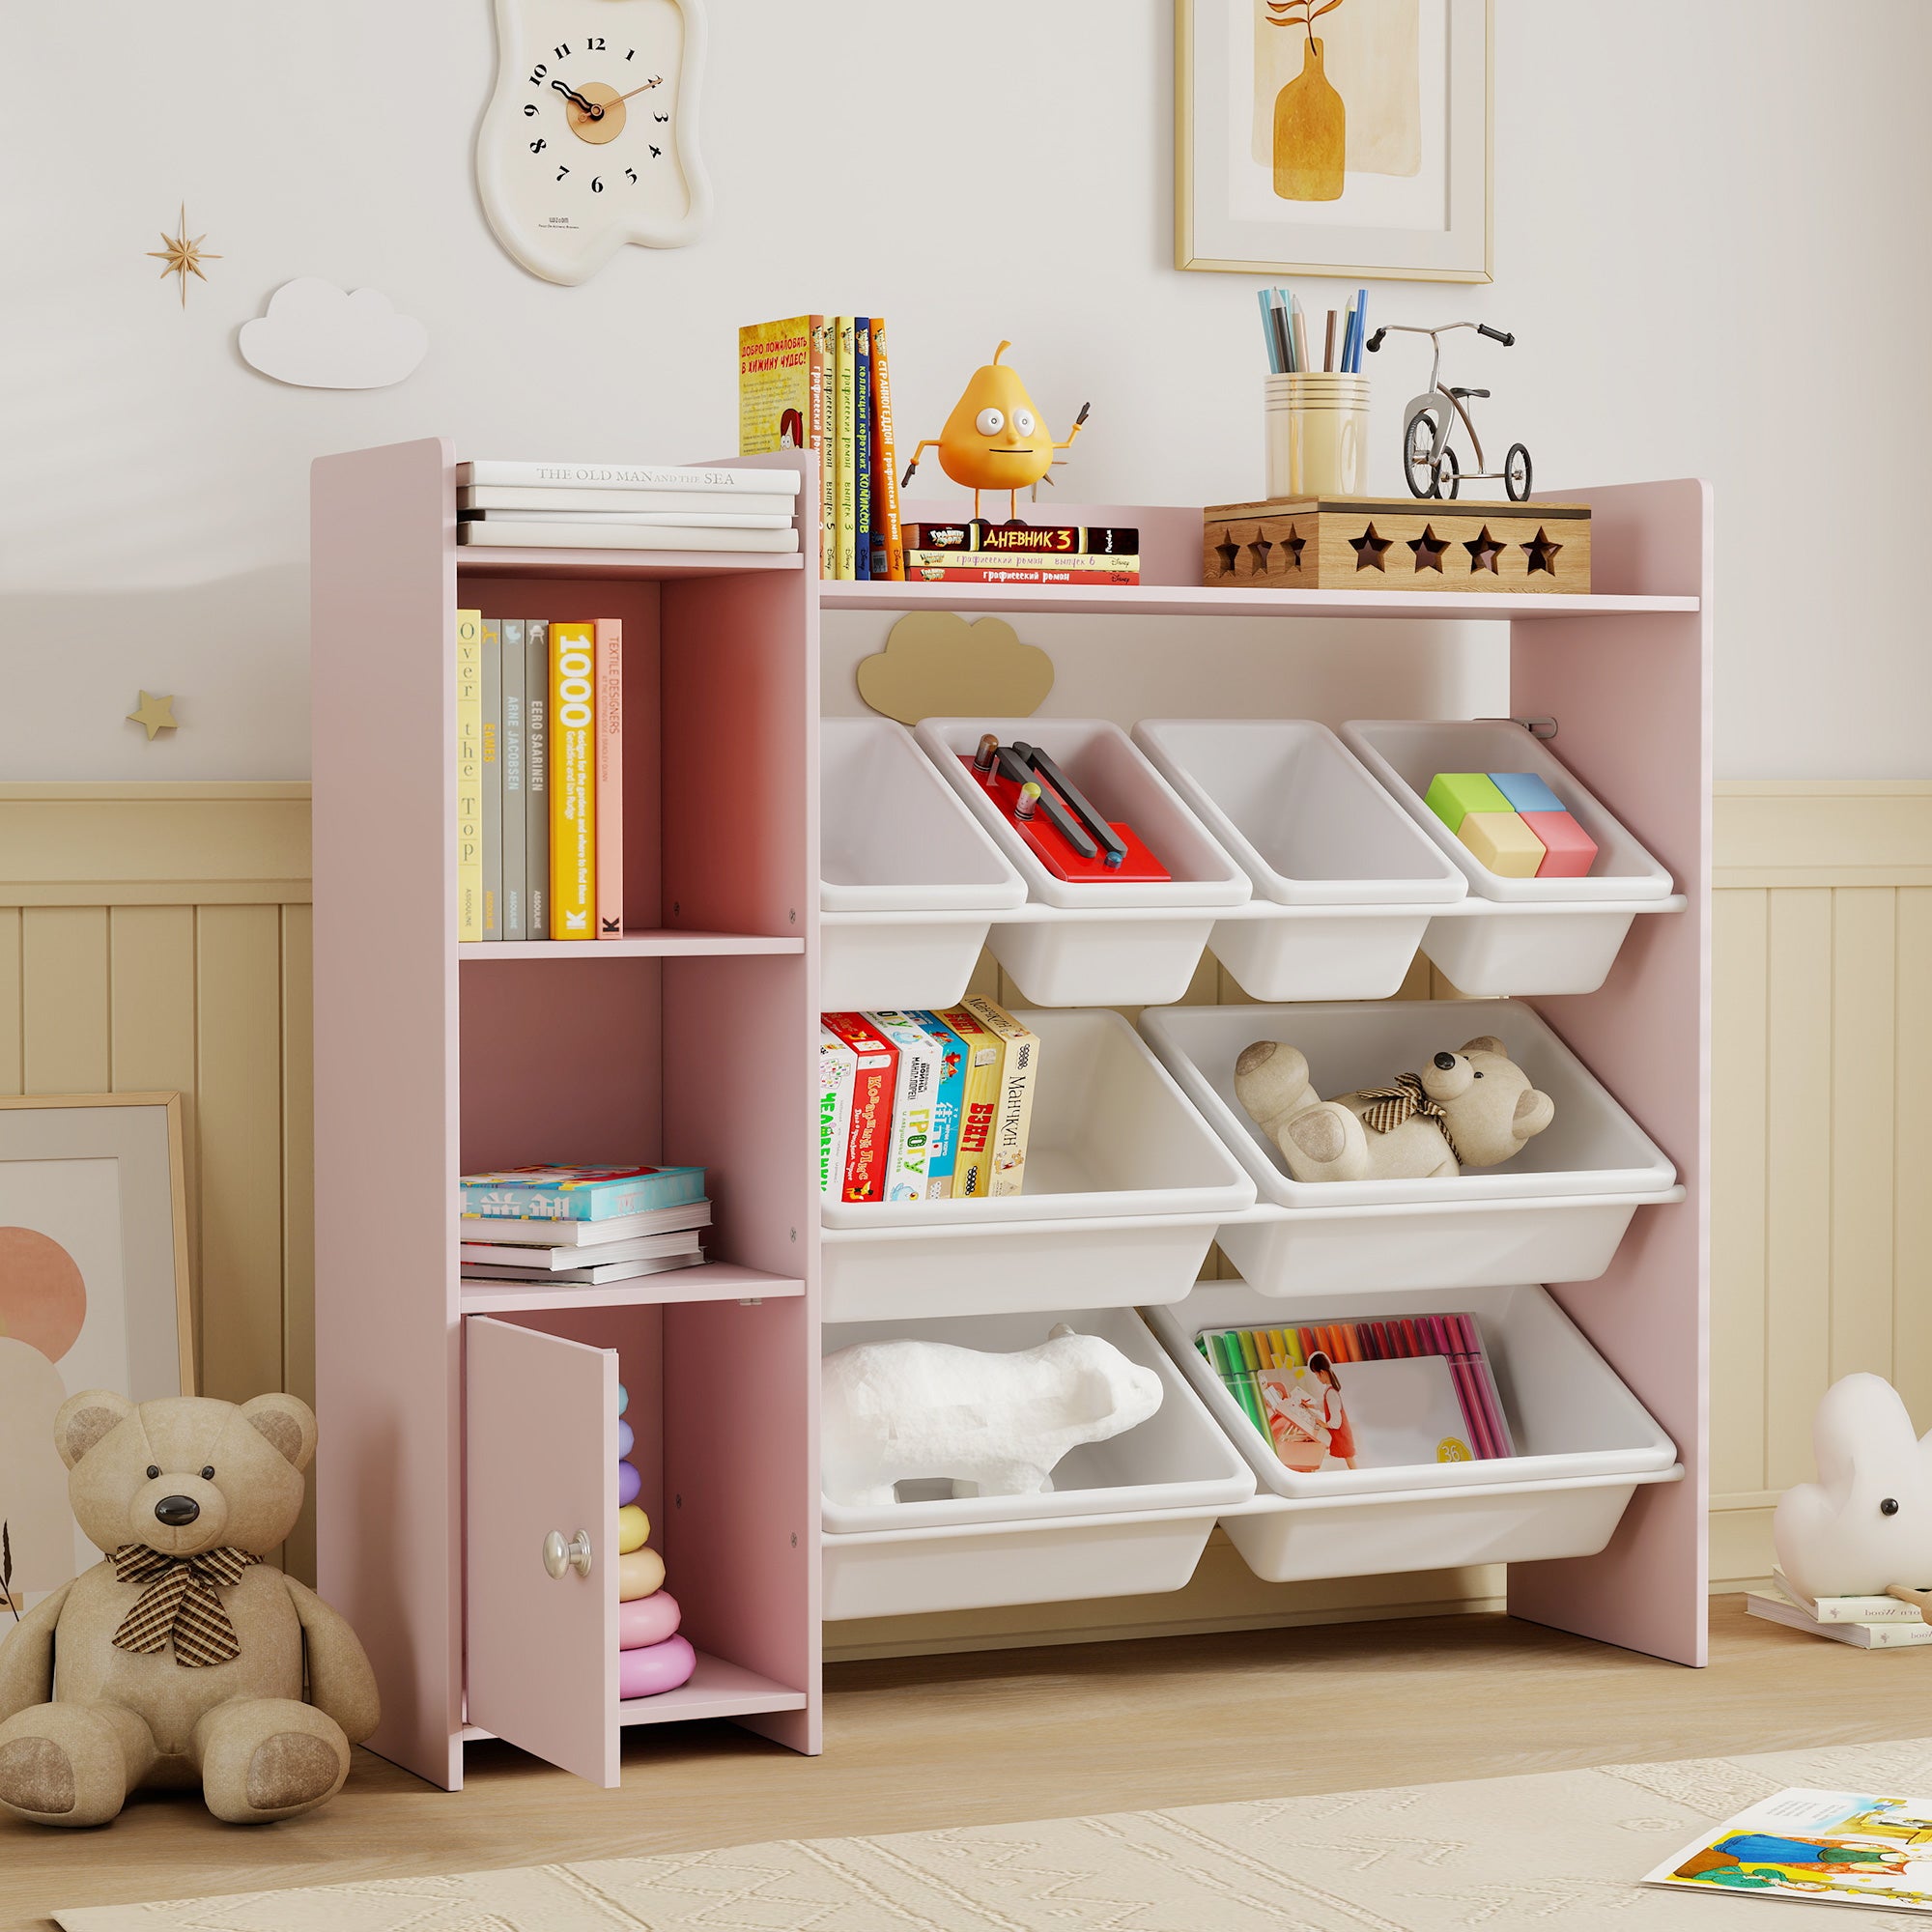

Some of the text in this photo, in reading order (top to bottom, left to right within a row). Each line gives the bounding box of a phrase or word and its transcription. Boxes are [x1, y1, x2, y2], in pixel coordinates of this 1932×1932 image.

[554, 43, 572, 60] 11
[586, 38, 606, 50] 12
[625, 48, 636, 62] 1
[528, 64, 548, 87] 10
[524, 104, 540, 117] 9
[653, 110, 669, 123] 3
[529, 138, 547, 154] 8
[648, 144, 662, 158] 4
[556, 165, 570, 182] 7
[591, 176, 604, 193] 6
[624, 167, 638, 185] 5
[742, 344, 763, 357] ДОБРО
[766, 336, 808, 353] ПОЖАЛОВАТЬ
[742, 352, 807, 375] В ХИЖИНУ ЧУДЕС!
[858, 366, 867, 419] коллекция
[878, 360, 893, 444] СТРАННОГЕДДОН
[856, 423, 867, 469] коротких
[536, 468, 735, 485] THE OLD MAN AND THE SEA
[883, 451, 896, 509] графический
[859, 473, 869, 533] КОМИКСОВ
[888, 513, 898, 540] роман
[983, 529, 1071, 550] ДНЕВНИК 3
[1090, 555, 1095, 566] 6
[1042, 572, 1070, 583] роман
[559, 635, 592, 728] 1000
[609, 637, 620, 735] TEXTILE DESIGNERS
[484, 723, 496, 763] EAMES
[507, 696, 520, 790] ARNE JACOBSEN
[531, 700, 544, 791] EERO SAARINEN
[602, 917, 619, 932] K
[1001, 1076, 1026, 1147] Манчкин
[857, 1075, 882, 1180] Коварный Лис
[960, 1103, 995, 1152] БЭНГ!
[903, 1108, 930, 1175] ГРОГУ
[1441, 1445, 1461, 1463] 36
